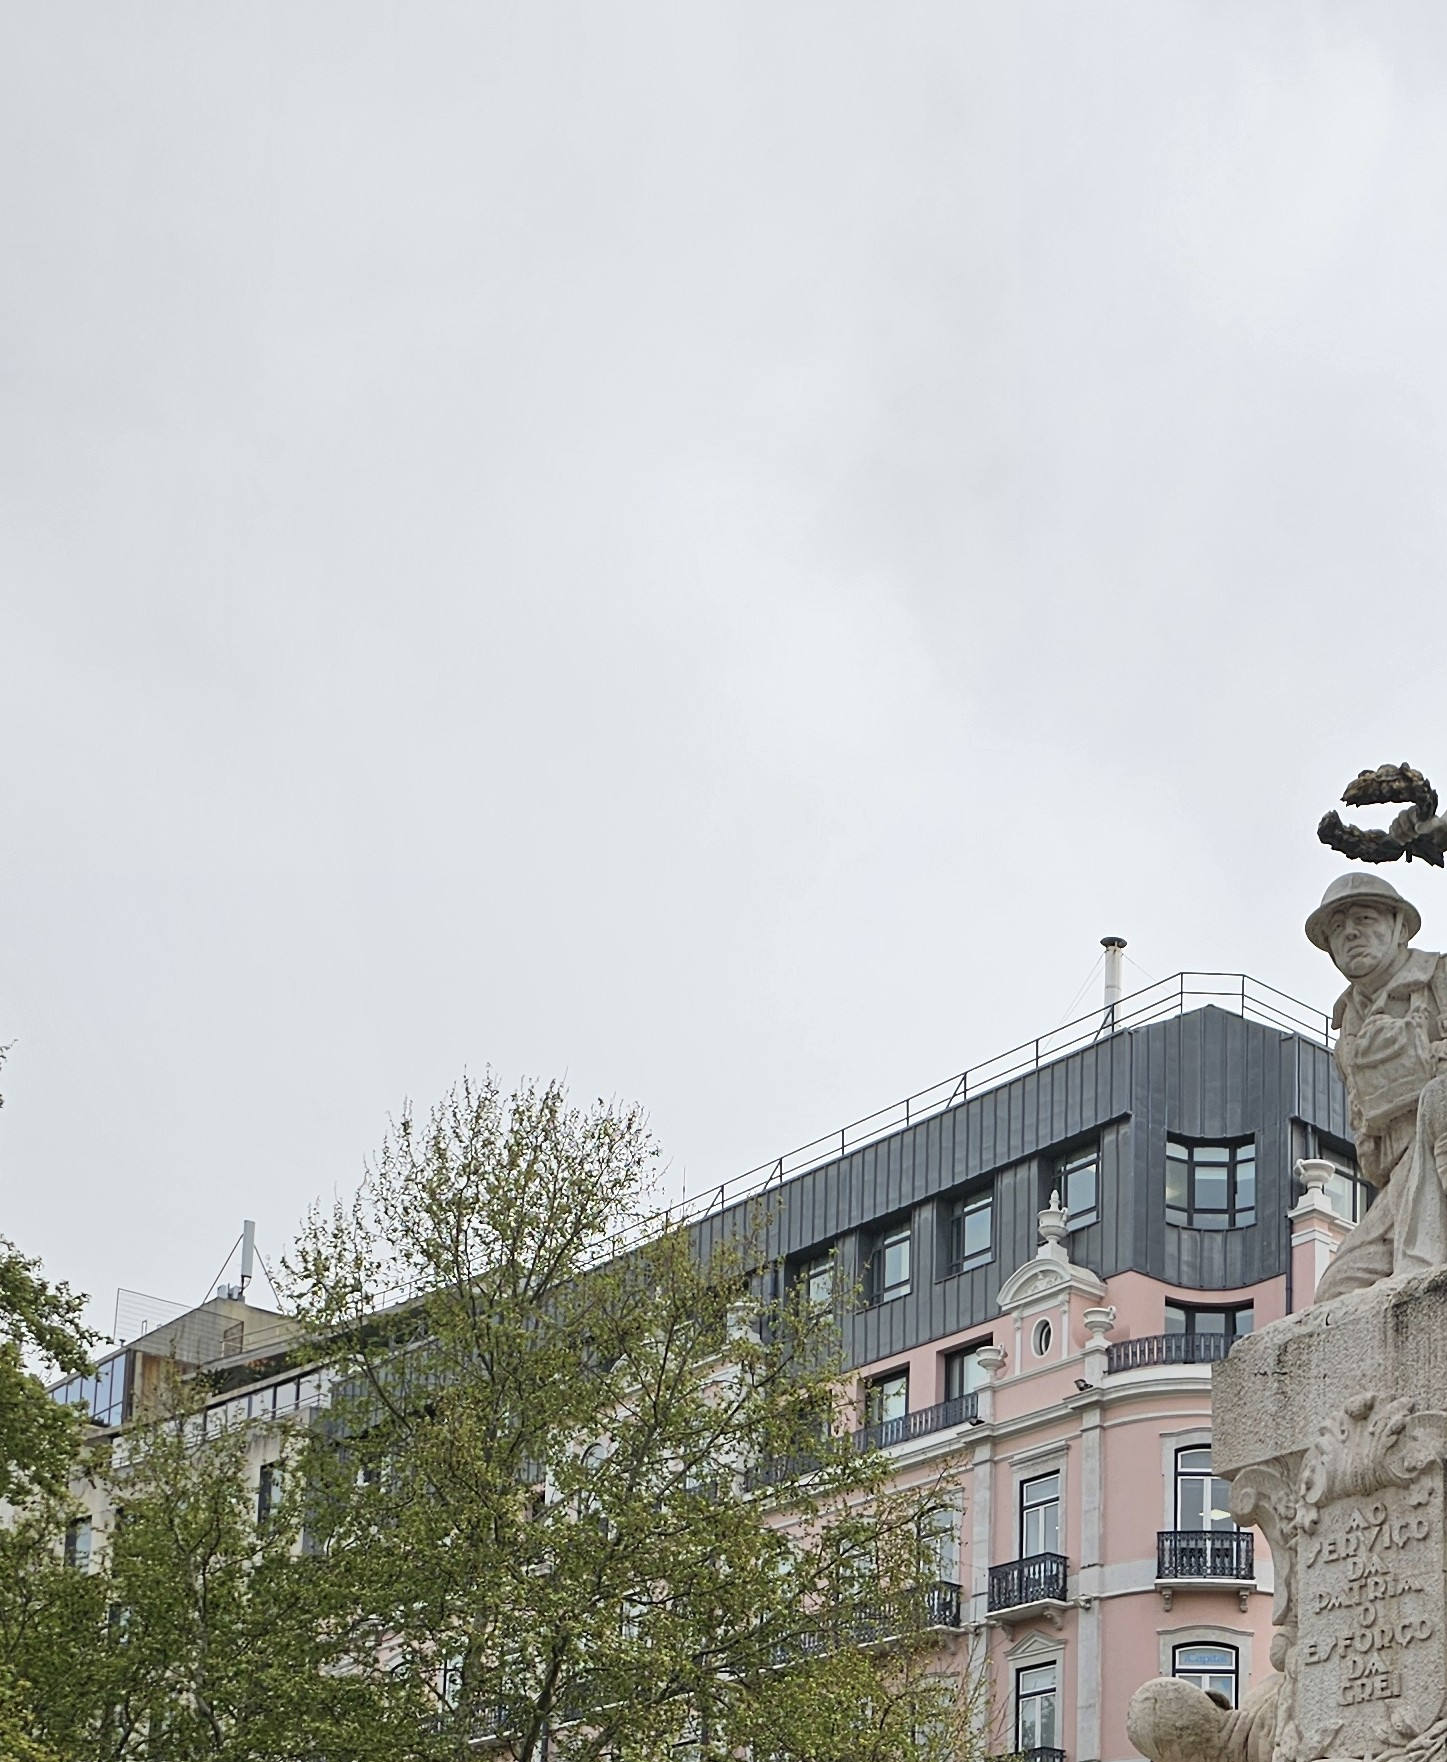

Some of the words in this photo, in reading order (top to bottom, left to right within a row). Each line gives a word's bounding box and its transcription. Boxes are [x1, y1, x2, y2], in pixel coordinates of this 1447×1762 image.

[1345, 1502, 1388, 1535] AO
[1306, 1517, 1430, 1569] SERVIÇO
[1347, 1553, 1391, 1582] DA
[1315, 1576, 1423, 1615] PATRIA
[1359, 1603, 1377, 1629] O
[1303, 1616, 1434, 1666] ESFORÇO
[1347, 1651, 1391, 1681] DA
[1338, 1672, 1402, 1707] GREI
